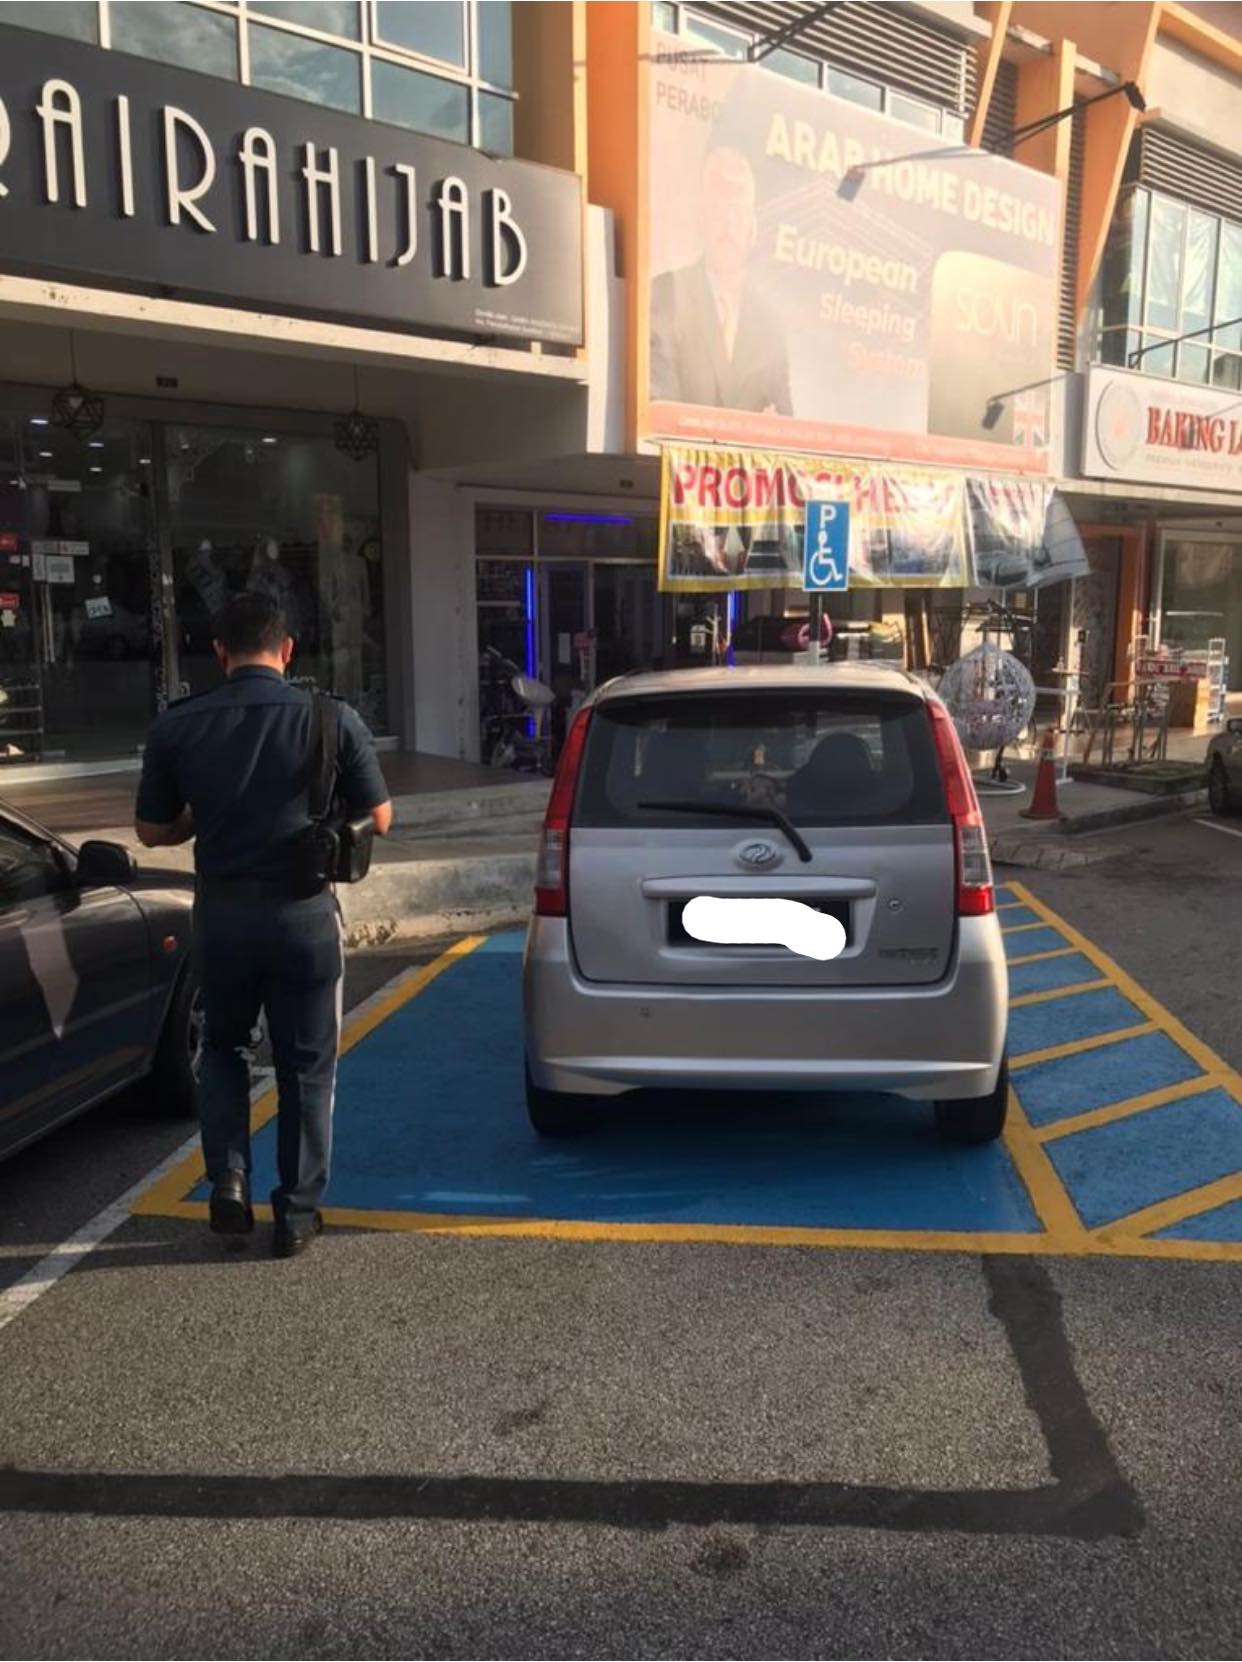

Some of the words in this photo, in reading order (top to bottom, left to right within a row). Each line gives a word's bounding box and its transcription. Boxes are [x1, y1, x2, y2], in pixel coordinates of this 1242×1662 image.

[765, 113, 865, 177] ARAB
[871, 149, 958, 215] HOME
[962, 179, 1056, 246] DESIGN
[774, 223, 918, 293] European
[818, 292, 917, 342] Sleeping
[1145, 406, 1225, 454] BAKING
[820, 504, 837, 529] P
